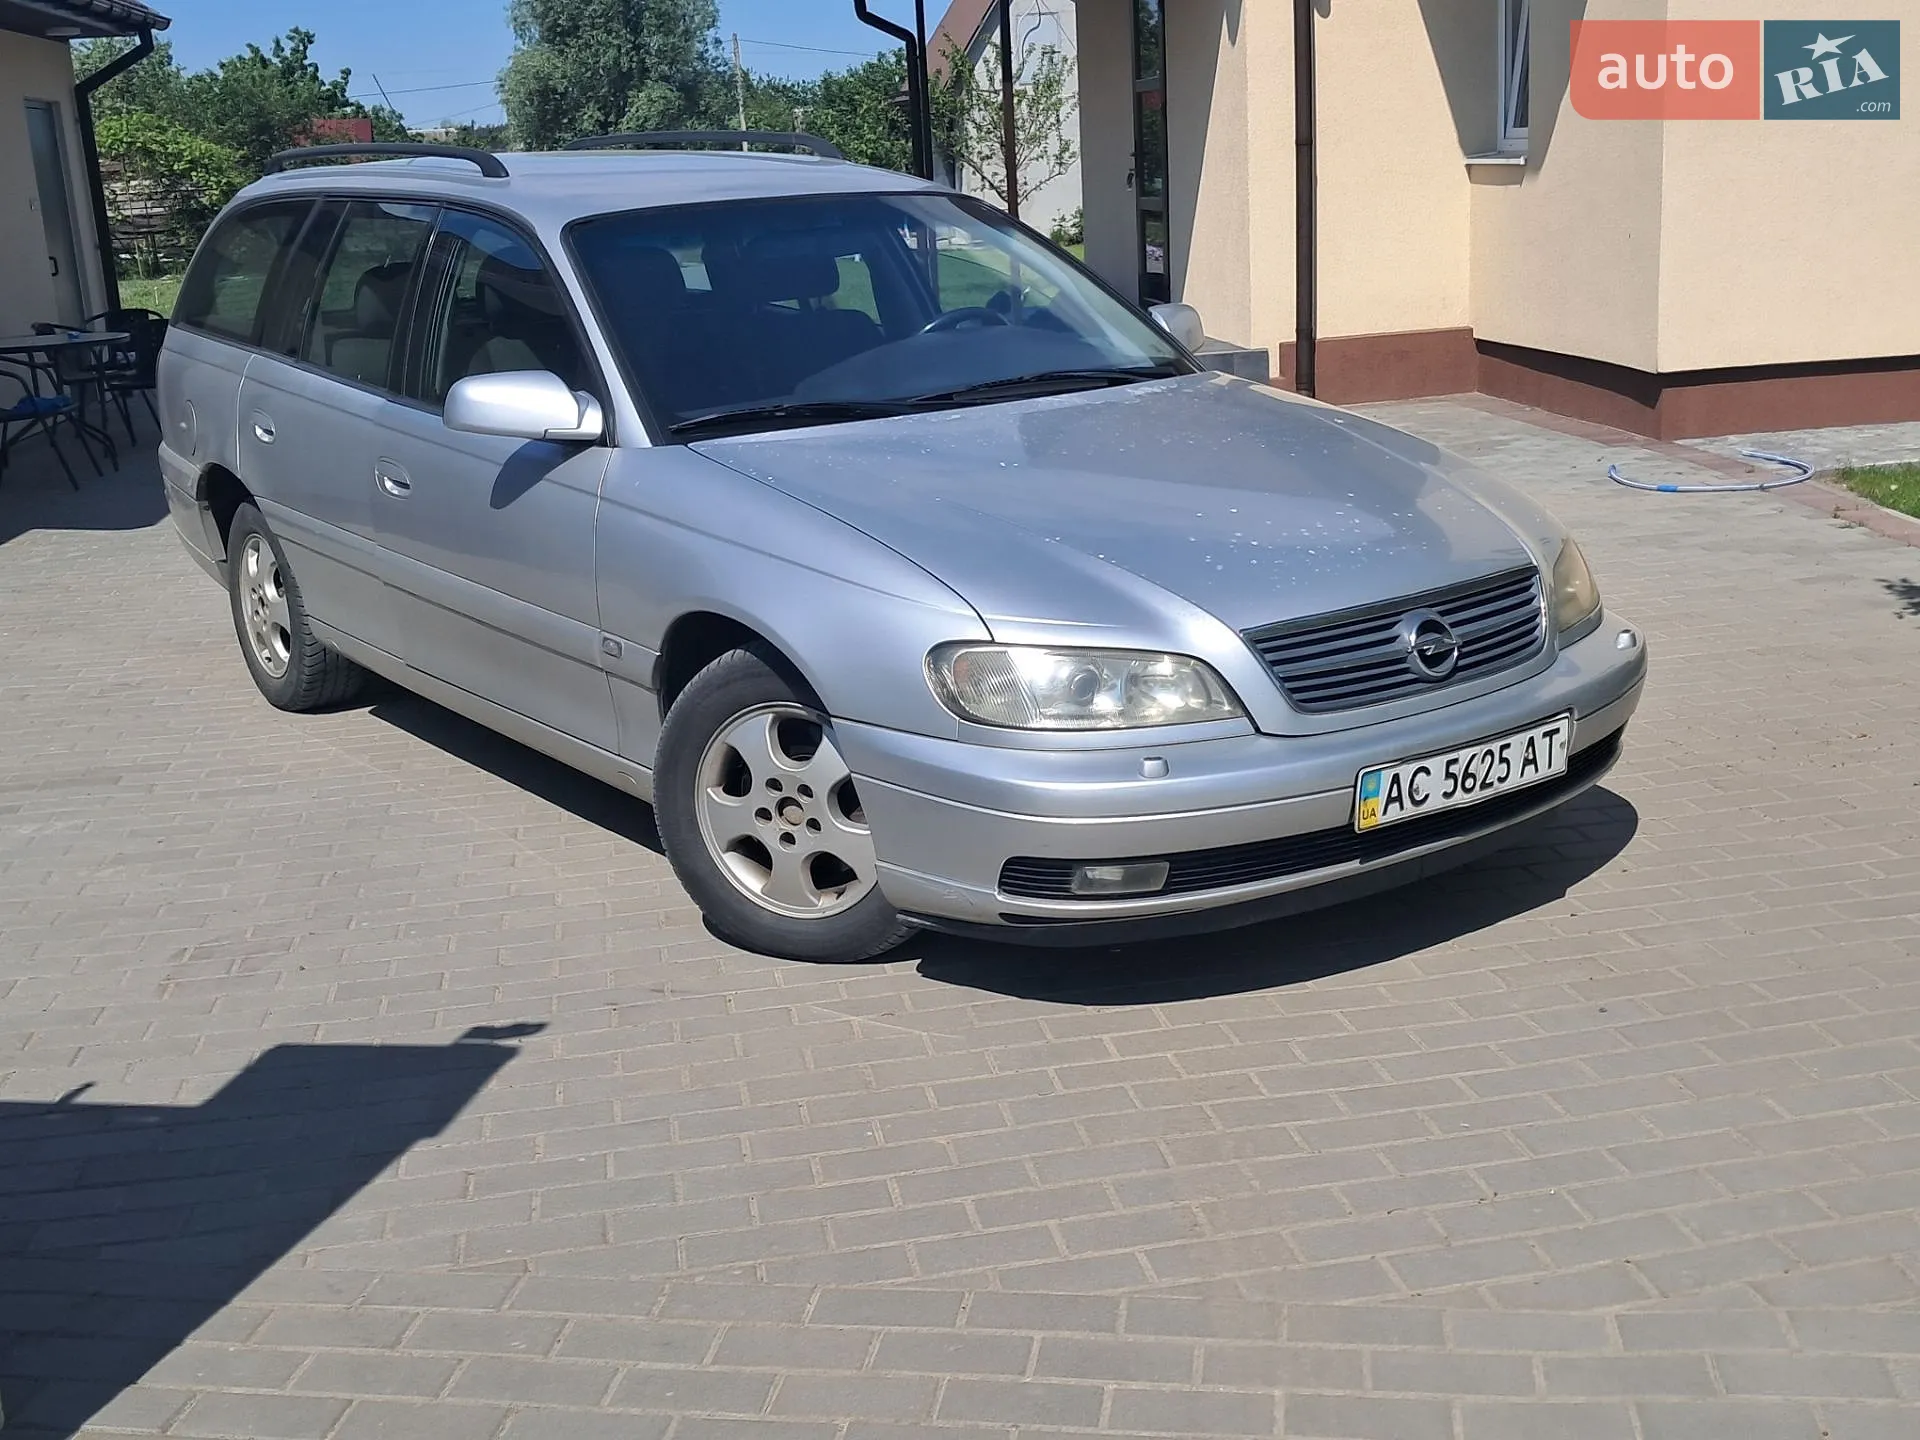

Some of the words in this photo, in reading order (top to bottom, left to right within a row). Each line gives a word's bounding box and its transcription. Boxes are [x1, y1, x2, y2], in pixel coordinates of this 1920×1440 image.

[1381, 765, 1432, 817] AC
[1441, 742, 1512, 800] 5625
[1519, 726, 1561, 779] AT
[1361, 807, 1377, 821] UA
